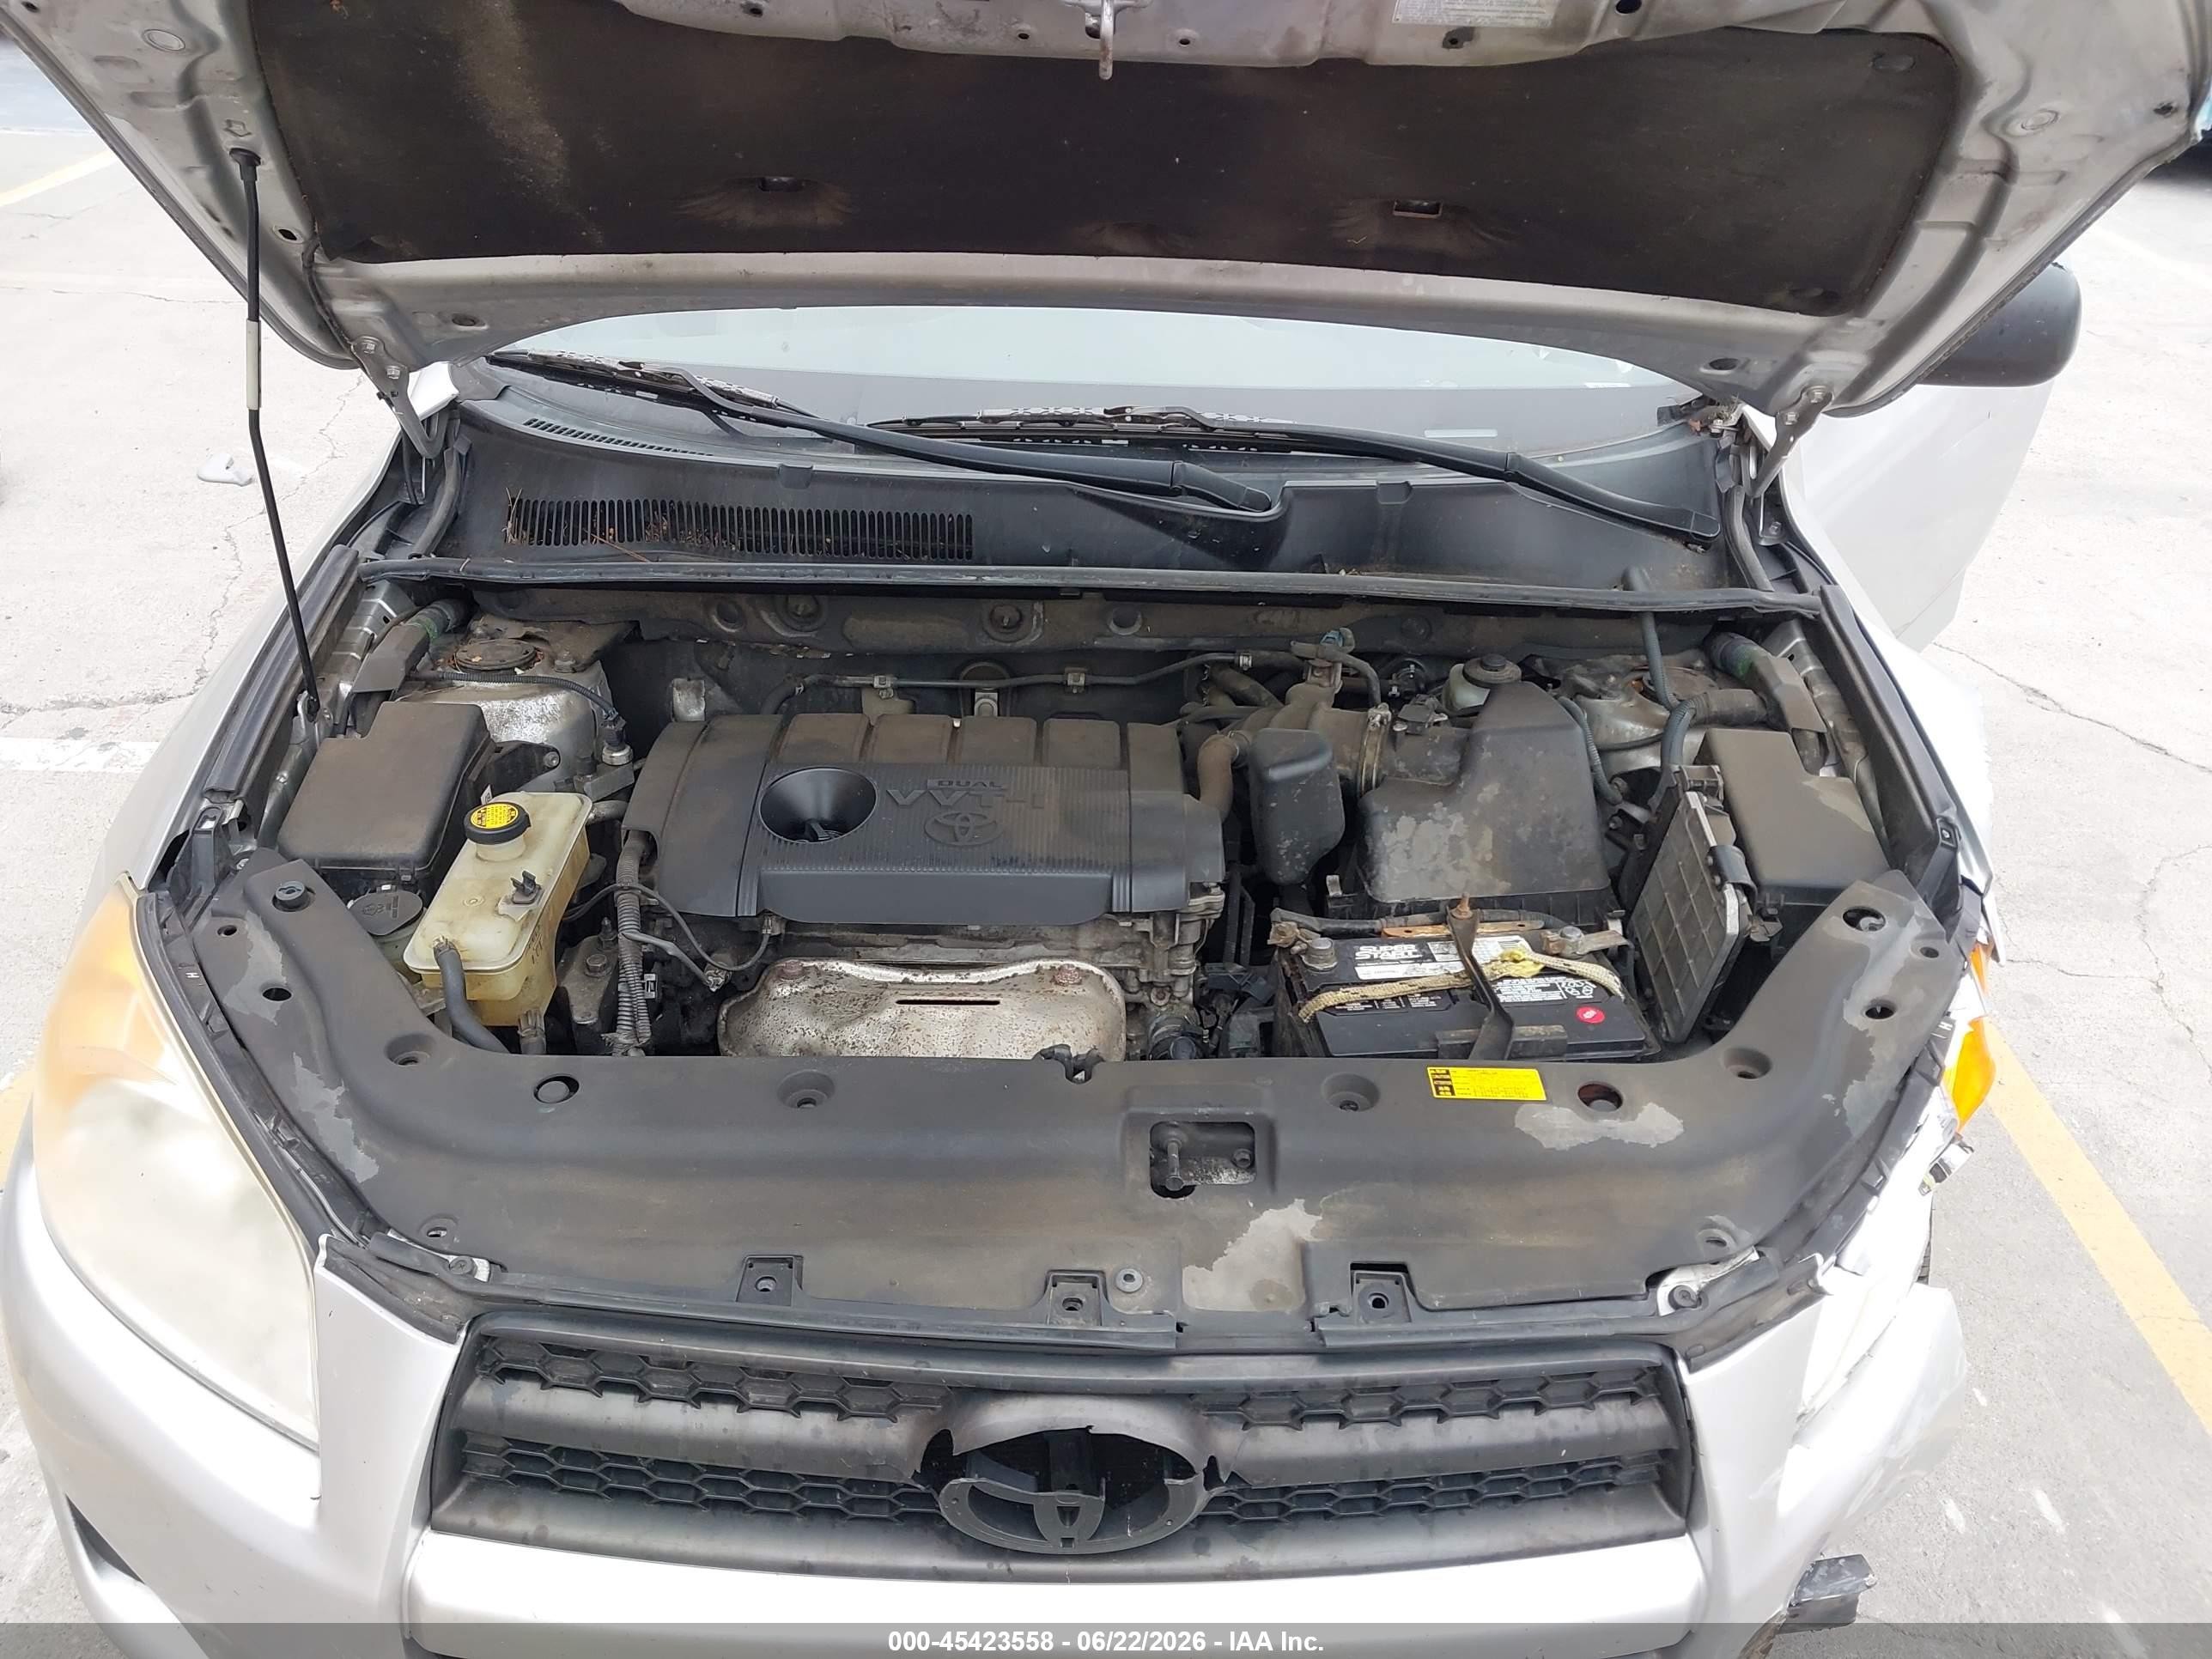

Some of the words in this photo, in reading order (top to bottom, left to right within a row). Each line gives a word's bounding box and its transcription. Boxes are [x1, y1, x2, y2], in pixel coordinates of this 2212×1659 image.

[937, 780, 1003, 788] DUAL
[1358, 944, 1416, 953] SUPER
[1354, 951, 1423, 961] START
